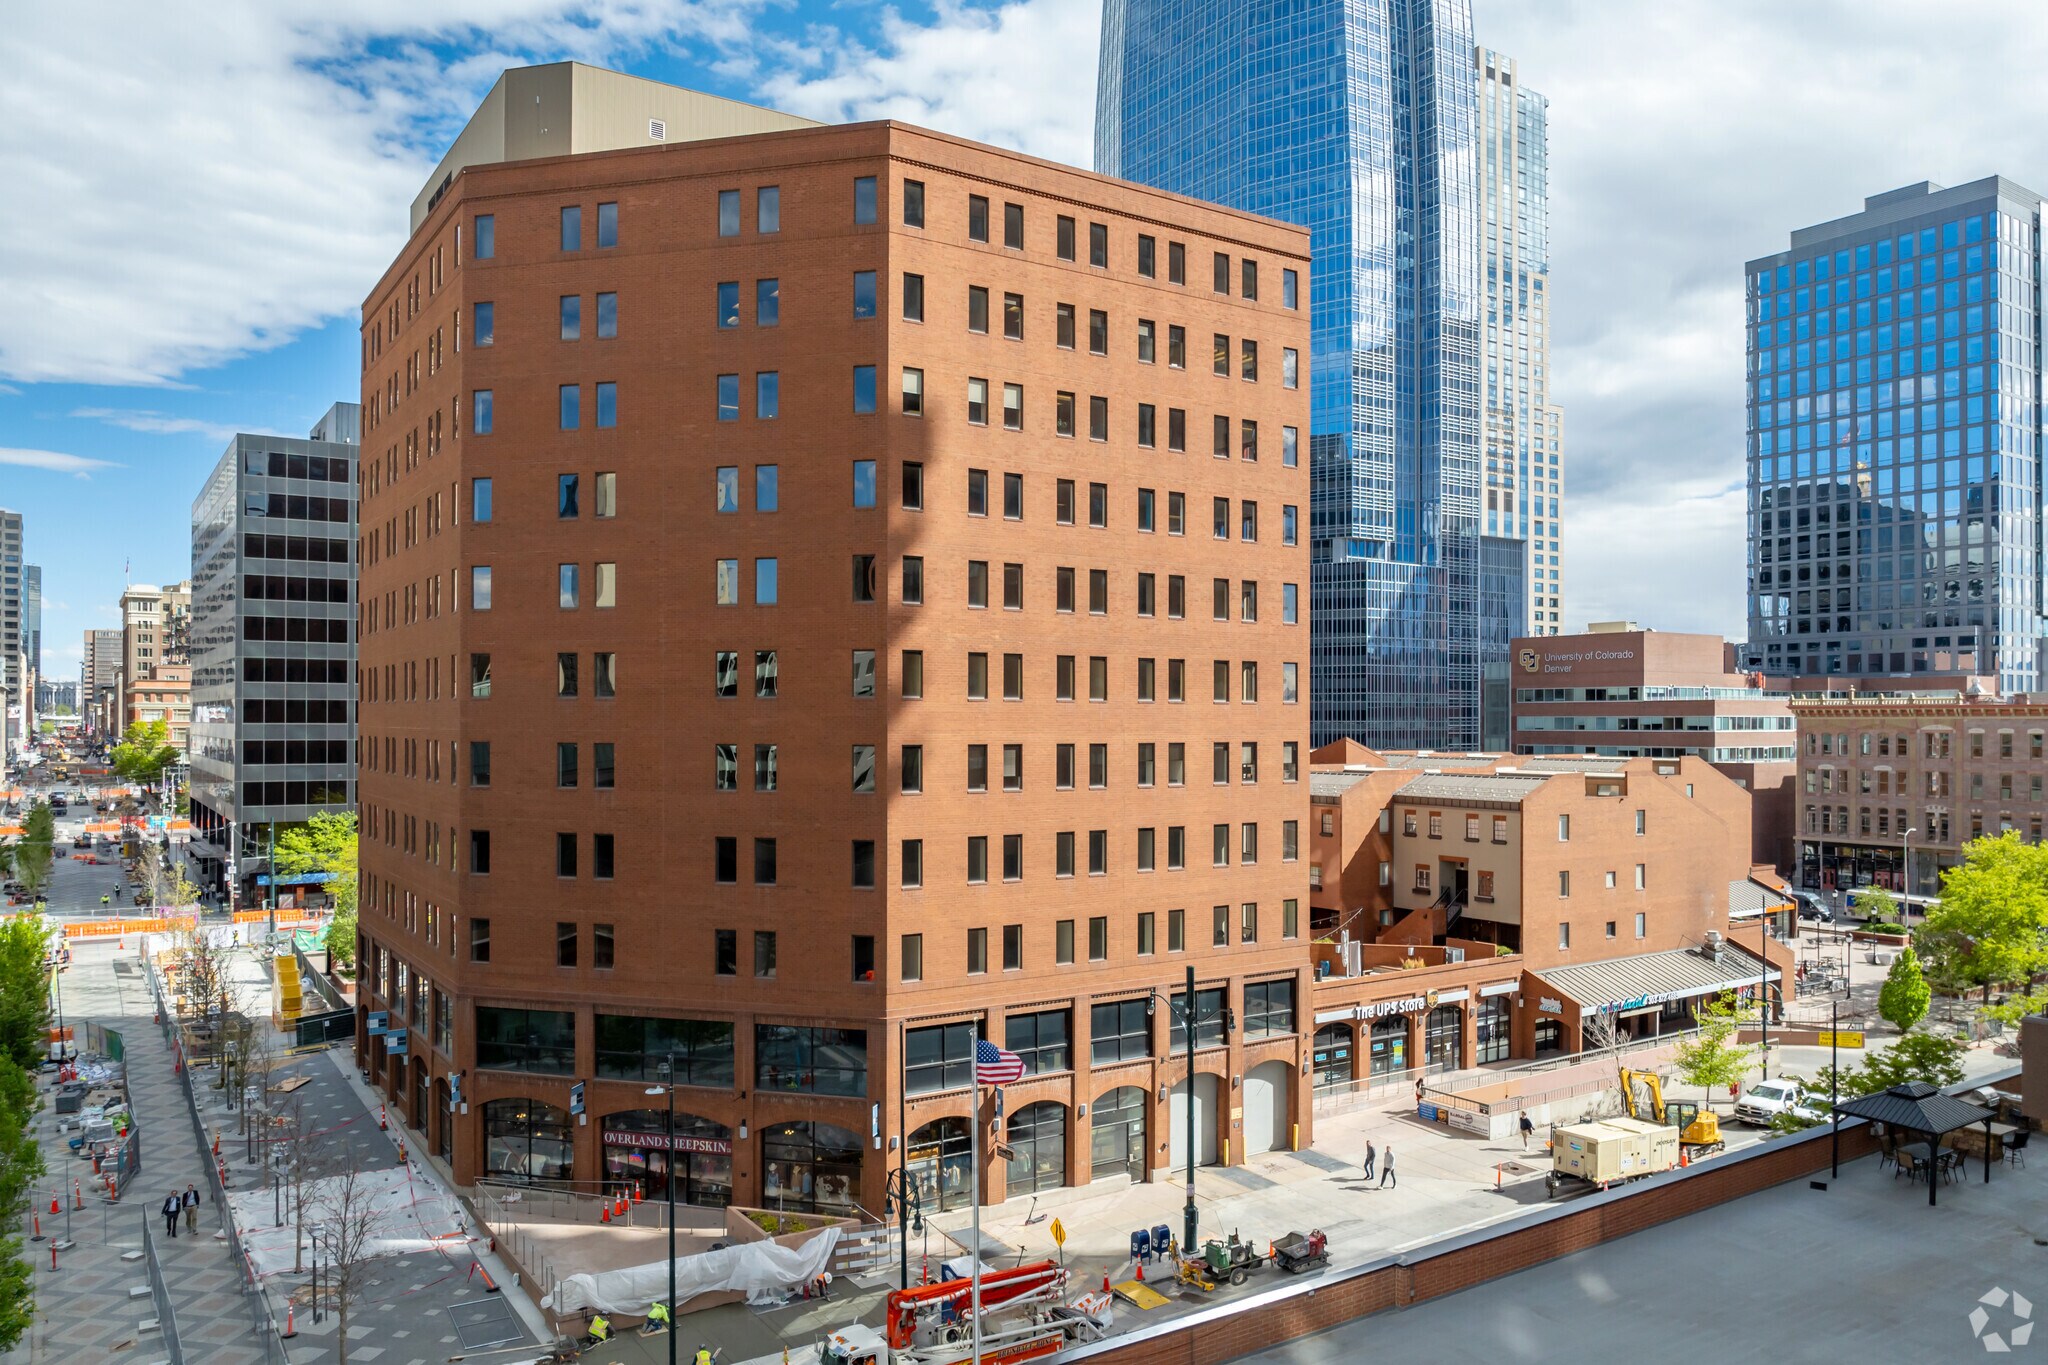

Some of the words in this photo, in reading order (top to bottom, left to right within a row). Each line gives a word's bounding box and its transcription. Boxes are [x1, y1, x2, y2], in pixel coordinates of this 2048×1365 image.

[1544, 652, 1582, 663] University
[1585, 650, 1594, 660] of
[1595, 649, 1634, 660] Colorado
[1544, 664, 1572, 673] Denver
[1355, 1005, 1374, 1020] The
[1376, 1001, 1397, 1016] UPS
[1399, 997, 1424, 1012] Store
[604, 1132, 663, 1147] OVERLAND
[1656, 1138, 1676, 1146] DOOSAN
